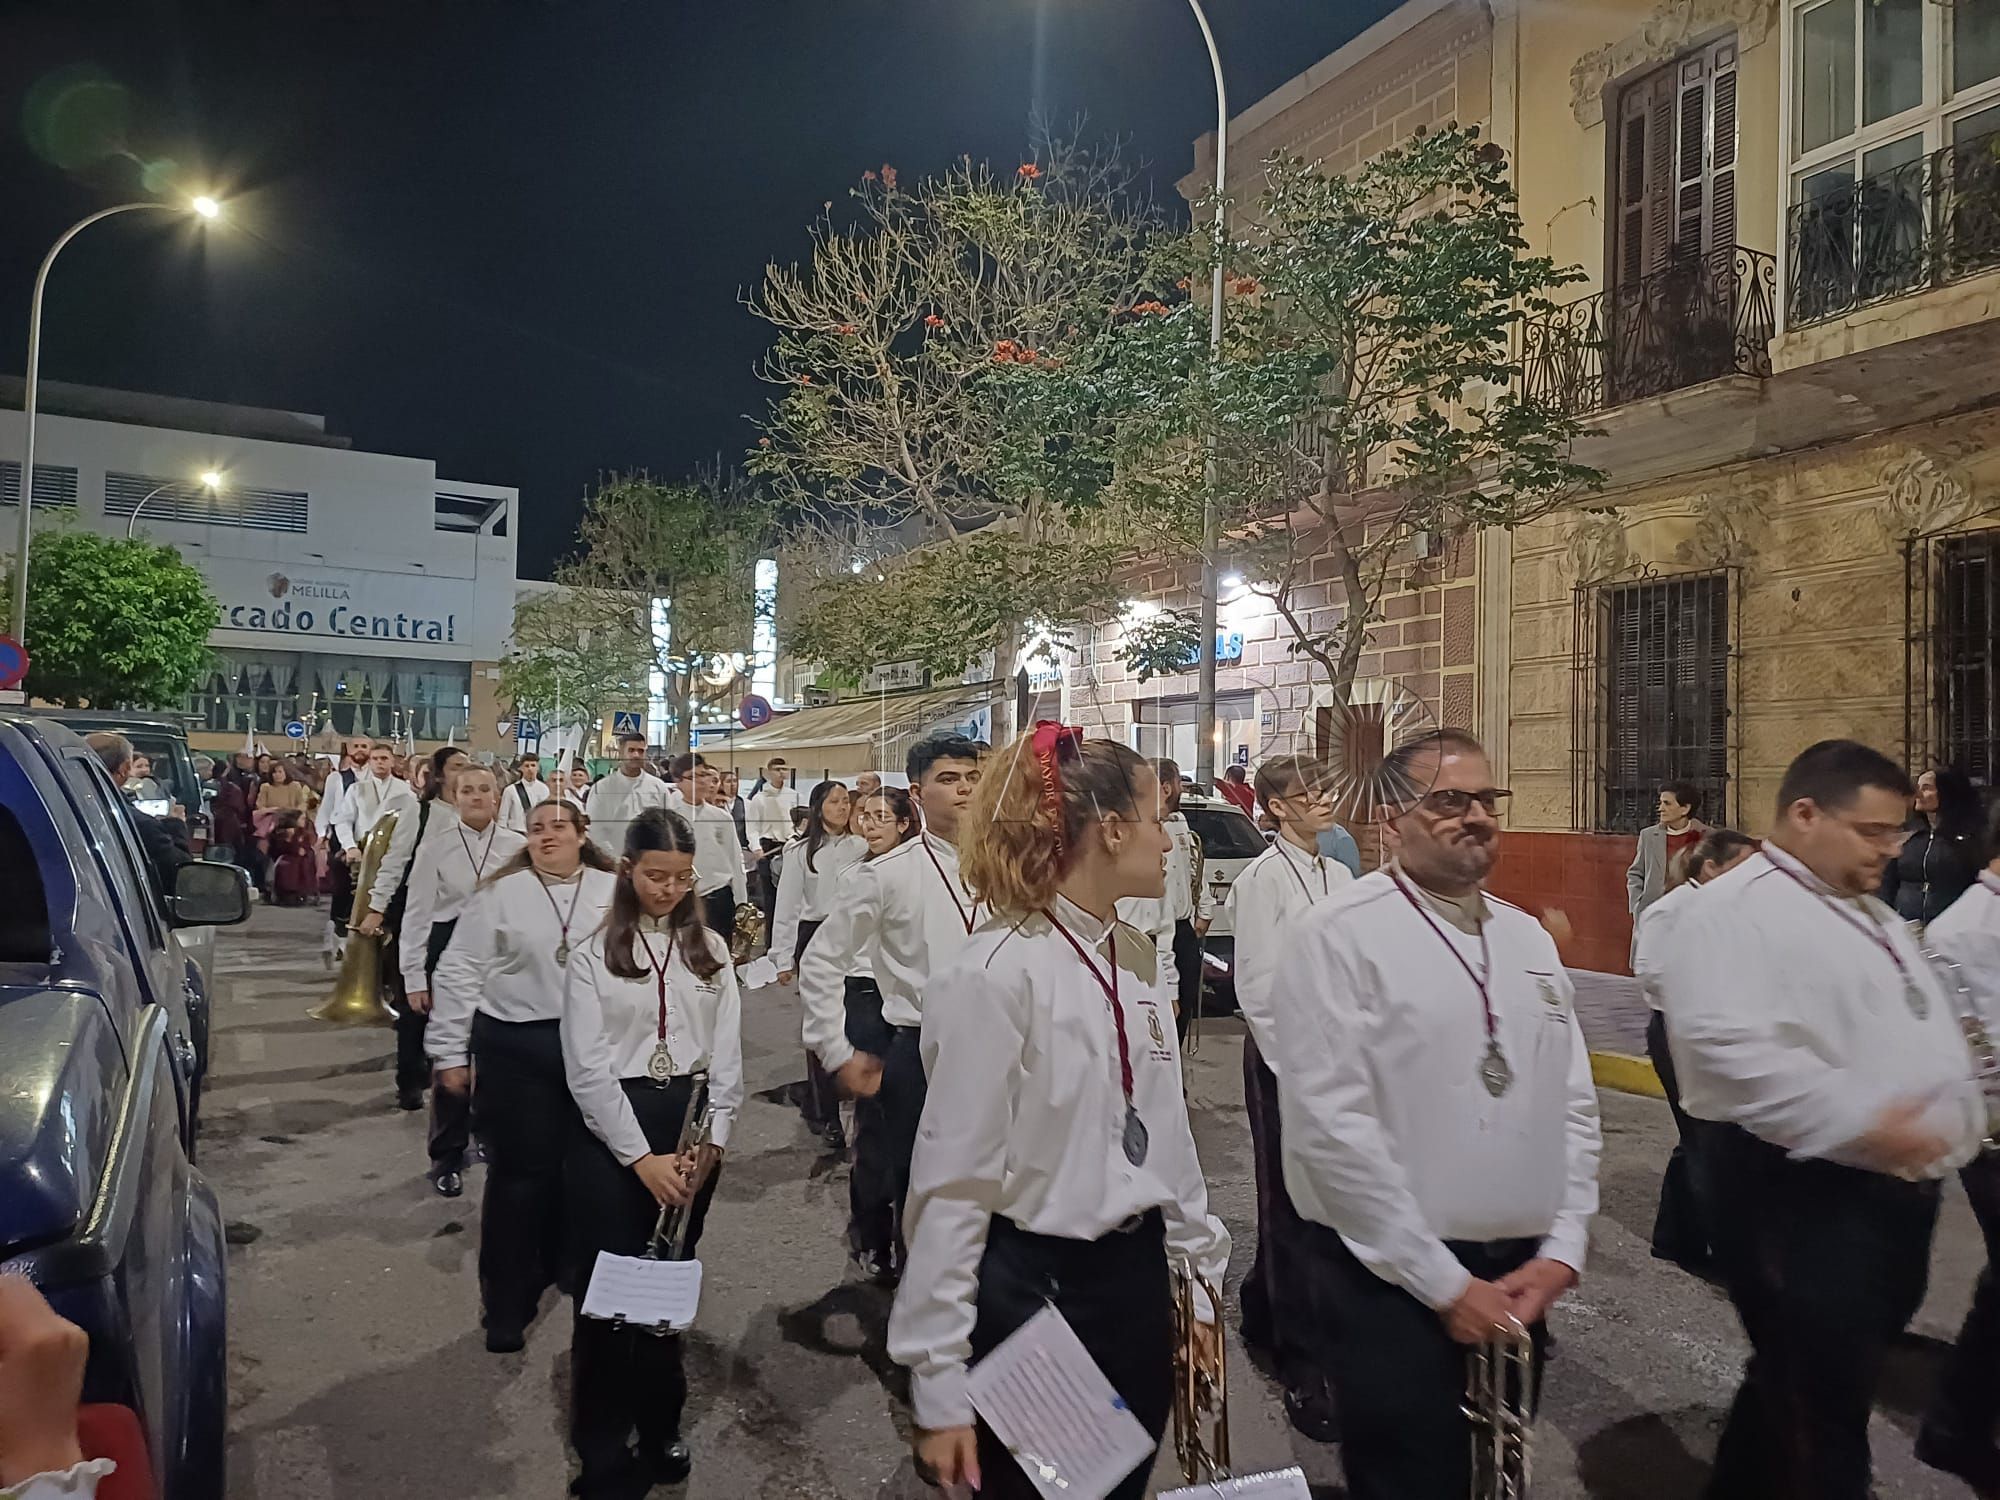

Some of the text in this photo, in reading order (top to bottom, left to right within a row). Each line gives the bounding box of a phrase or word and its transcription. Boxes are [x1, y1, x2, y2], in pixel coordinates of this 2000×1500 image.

[291, 585, 350, 600] MELILLA
[328, 605, 455, 642] Central
[1039, 751, 1056, 801] MAYOR
